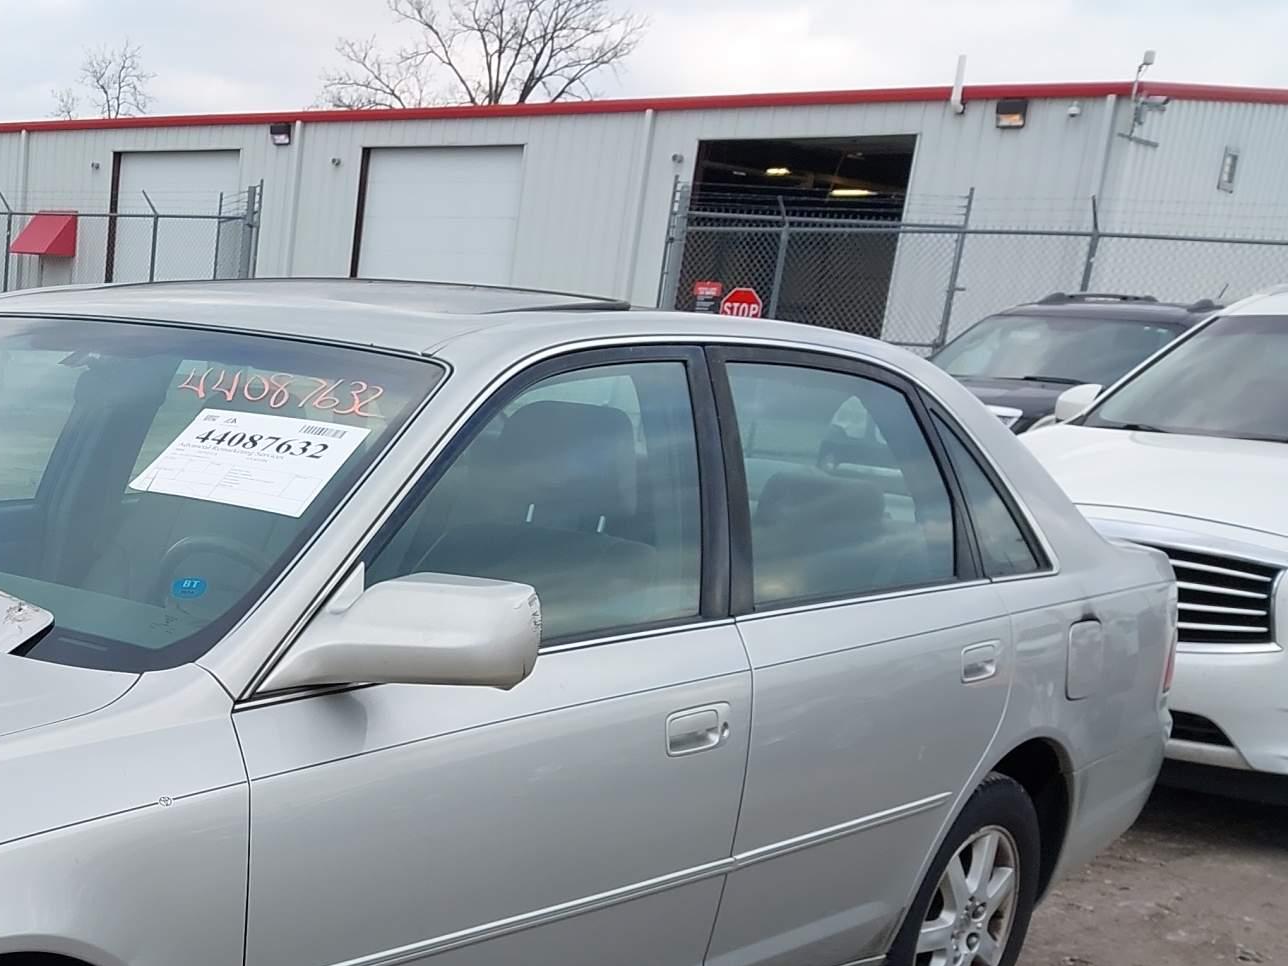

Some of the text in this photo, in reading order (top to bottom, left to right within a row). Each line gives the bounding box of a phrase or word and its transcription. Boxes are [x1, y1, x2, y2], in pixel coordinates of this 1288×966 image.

[723, 302, 759, 318] STOP
[178, 367, 385, 418] 44087632
[195, 428, 329, 459] 44087632
